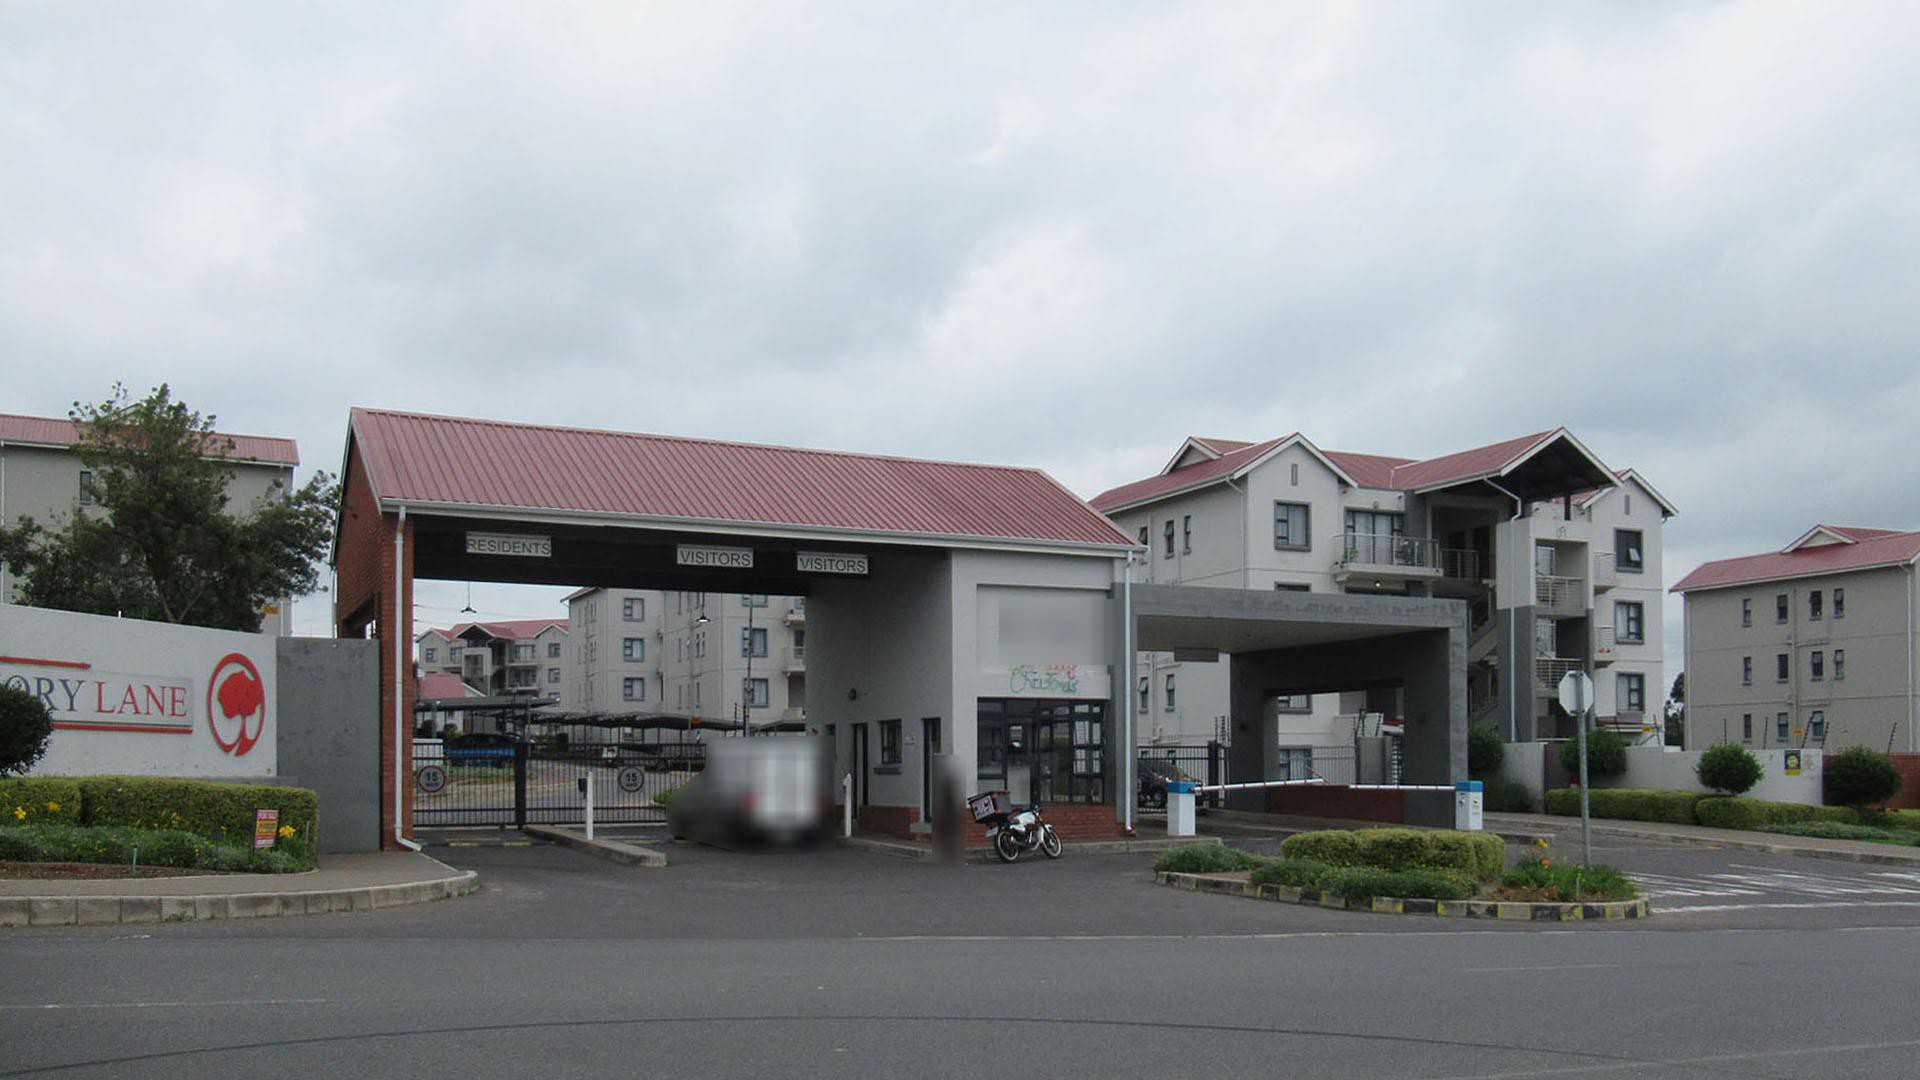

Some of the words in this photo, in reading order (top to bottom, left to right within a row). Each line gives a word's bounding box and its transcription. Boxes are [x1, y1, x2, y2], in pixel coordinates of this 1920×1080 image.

[466, 538, 551, 555] RESIDENTS
[680, 551, 751, 566] VISITORS
[799, 557, 866, 573] VISITORS
[95, 681, 188, 717] LANE
[425, 771, 439, 782] 15
[626, 772, 638, 782] 15
